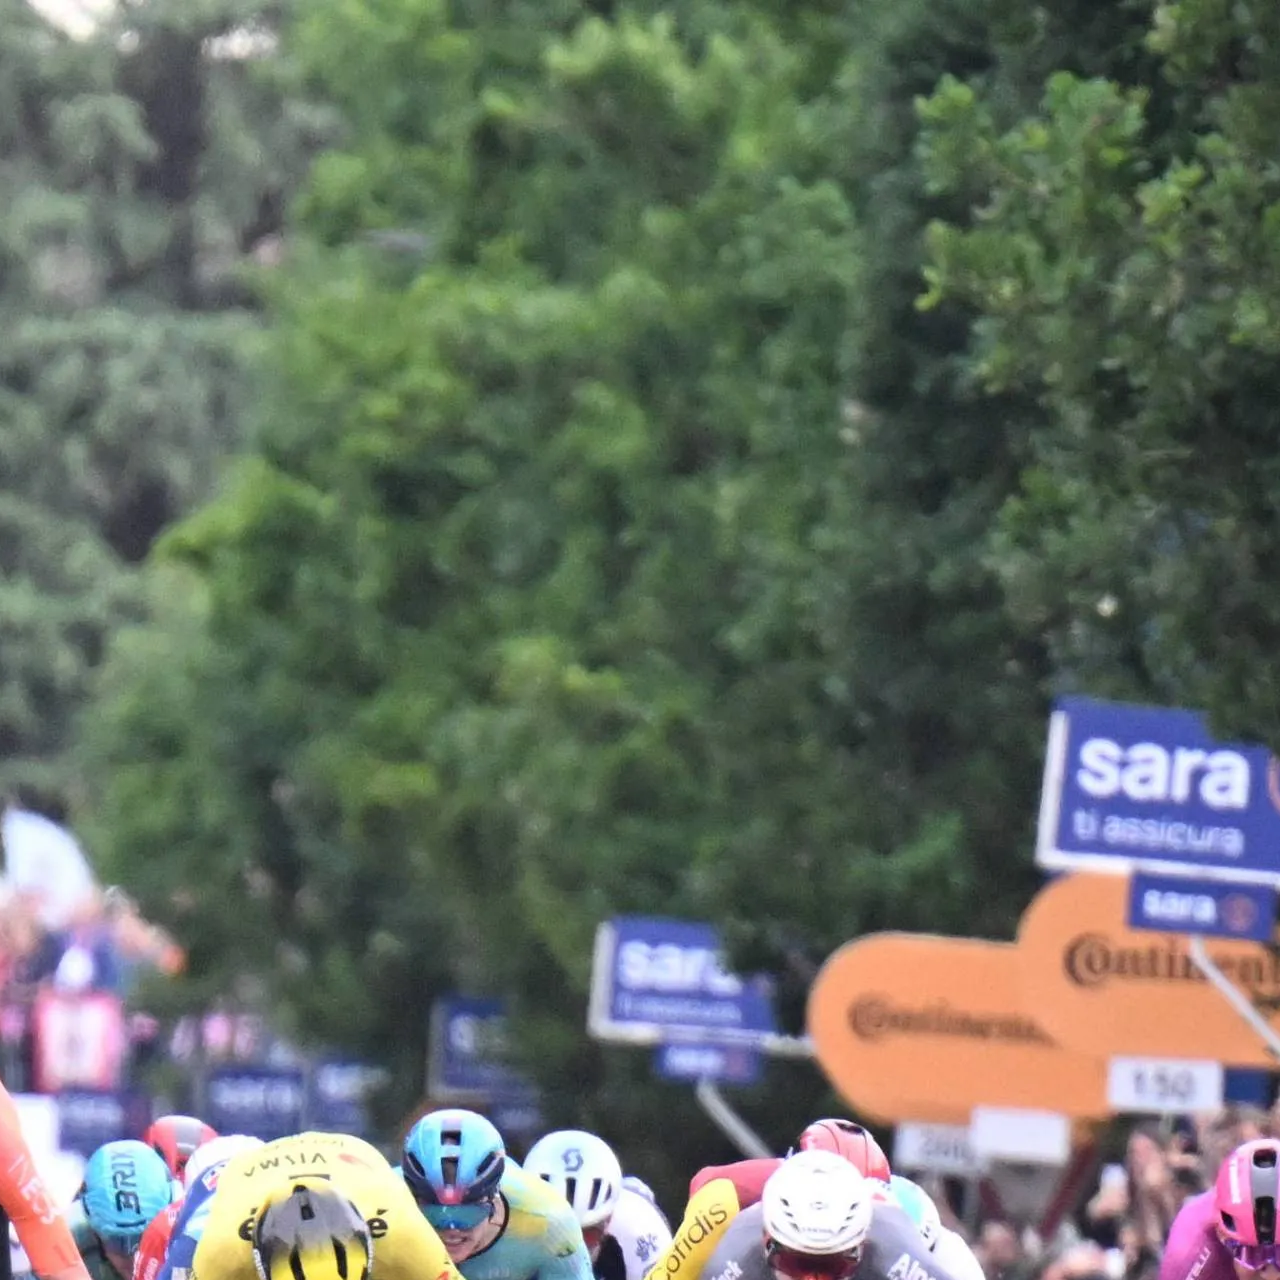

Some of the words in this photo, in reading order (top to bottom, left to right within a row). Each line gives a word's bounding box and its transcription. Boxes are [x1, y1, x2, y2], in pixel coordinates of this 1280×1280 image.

[1074, 736, 1252, 811] sara
[1103, 814, 1246, 858] assicura
[1141, 886, 1218, 921] sara
